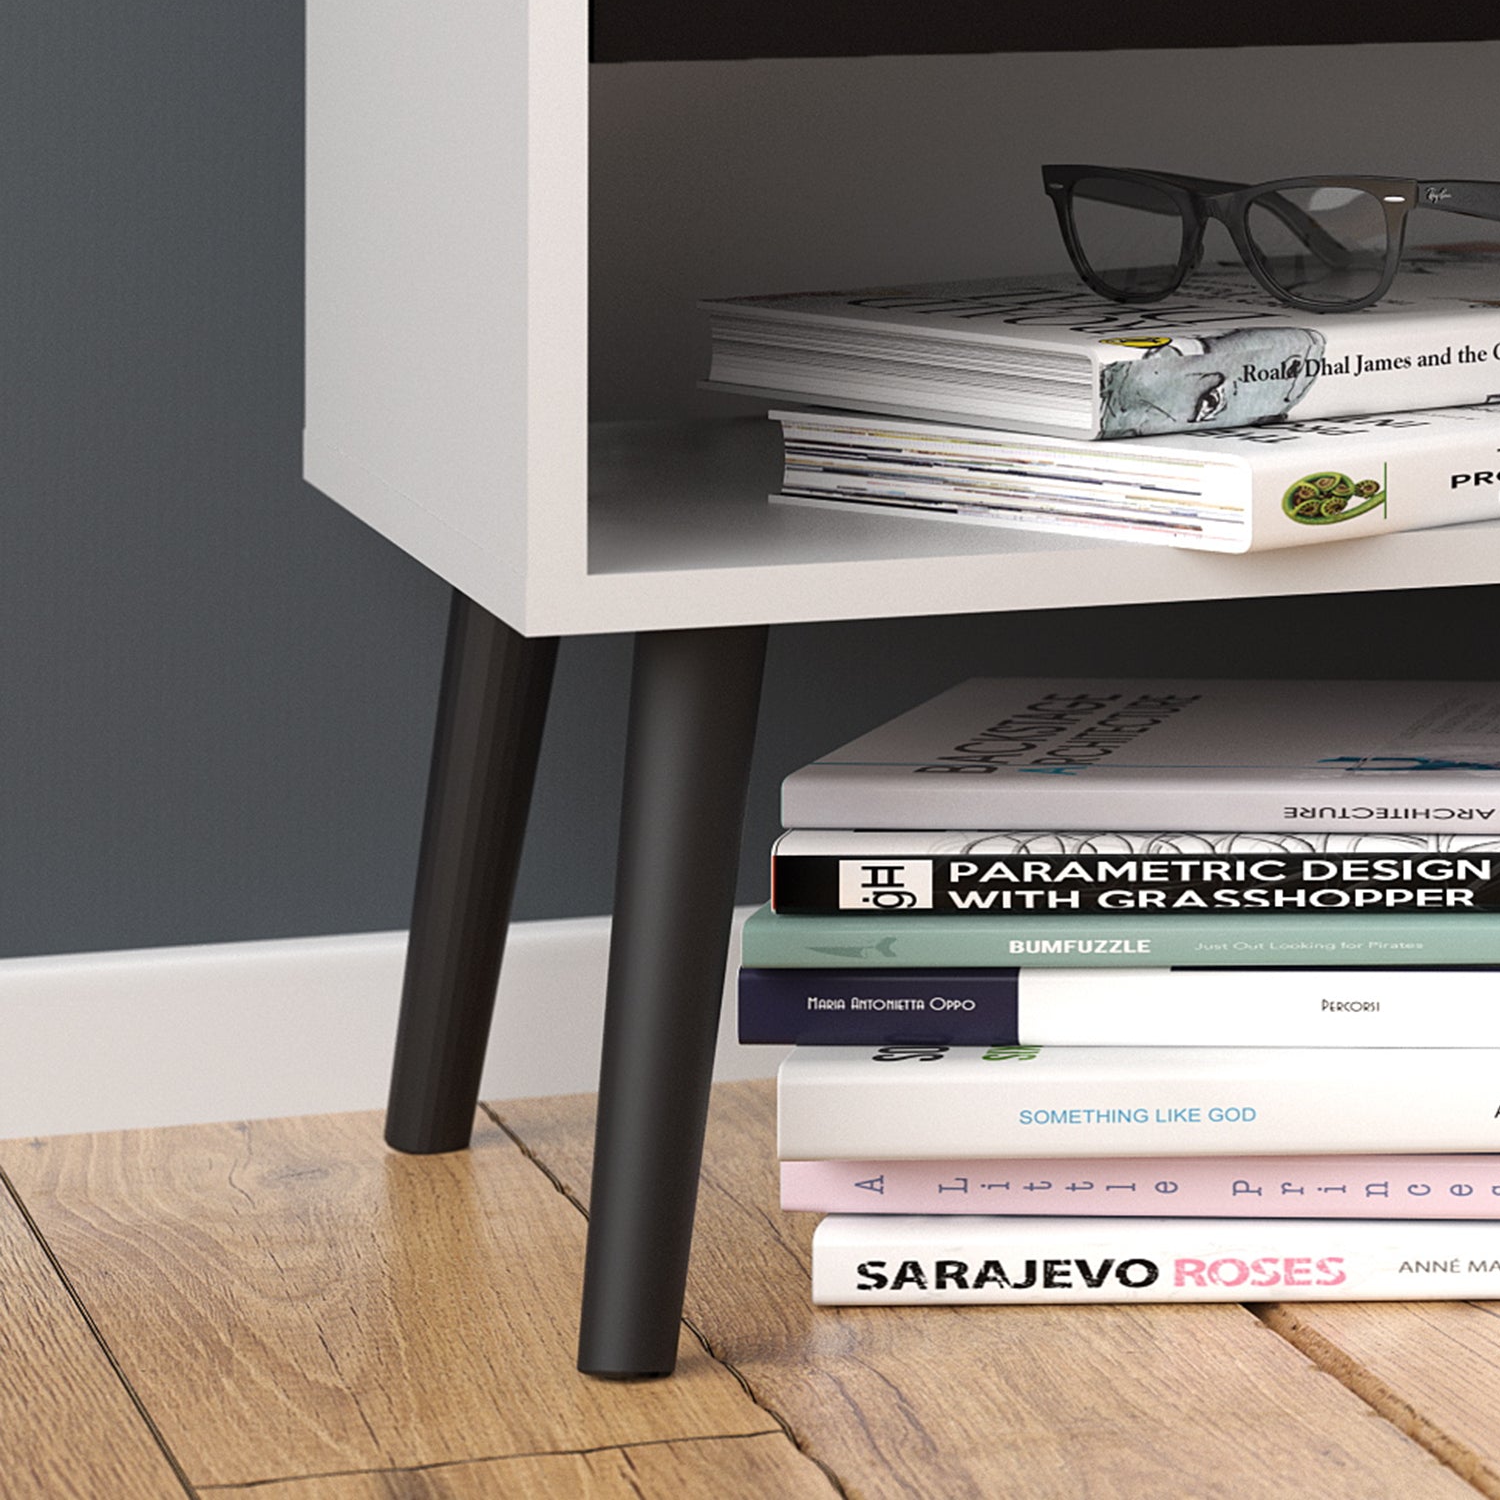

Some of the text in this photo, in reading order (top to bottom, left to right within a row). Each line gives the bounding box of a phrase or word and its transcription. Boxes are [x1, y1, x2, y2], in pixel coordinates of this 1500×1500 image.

[1242, 358, 1301, 383] Roald
[1304, 355, 1350, 378] Dhal
[1354, 354, 1412, 377] James
[1417, 346, 1452, 368] and
[1457, 344, 1488, 364] the
[913, 693, 1123, 775] BACKSTAGE
[1283, 805, 1496, 820] ARCHITECTURE
[950, 858, 1492, 883] PARAMETRIC DESIGN
[947, 887, 1475, 909] WITH GRASSHOPPER
[1008, 939, 1151, 954] BUMFUZZLE
[1194, 940, 1425, 952] Just Out Looking for Pirates
[1019, 1106, 1257, 1125] SOMETHING LIKE GOD
[854, 1174, 885, 1195] A
[937, 1177, 1179, 1194] Little
[855, 1256, 1347, 1291] SARAJEVO ROSES
[1398, 1257, 1461, 1274] ANNÉ
